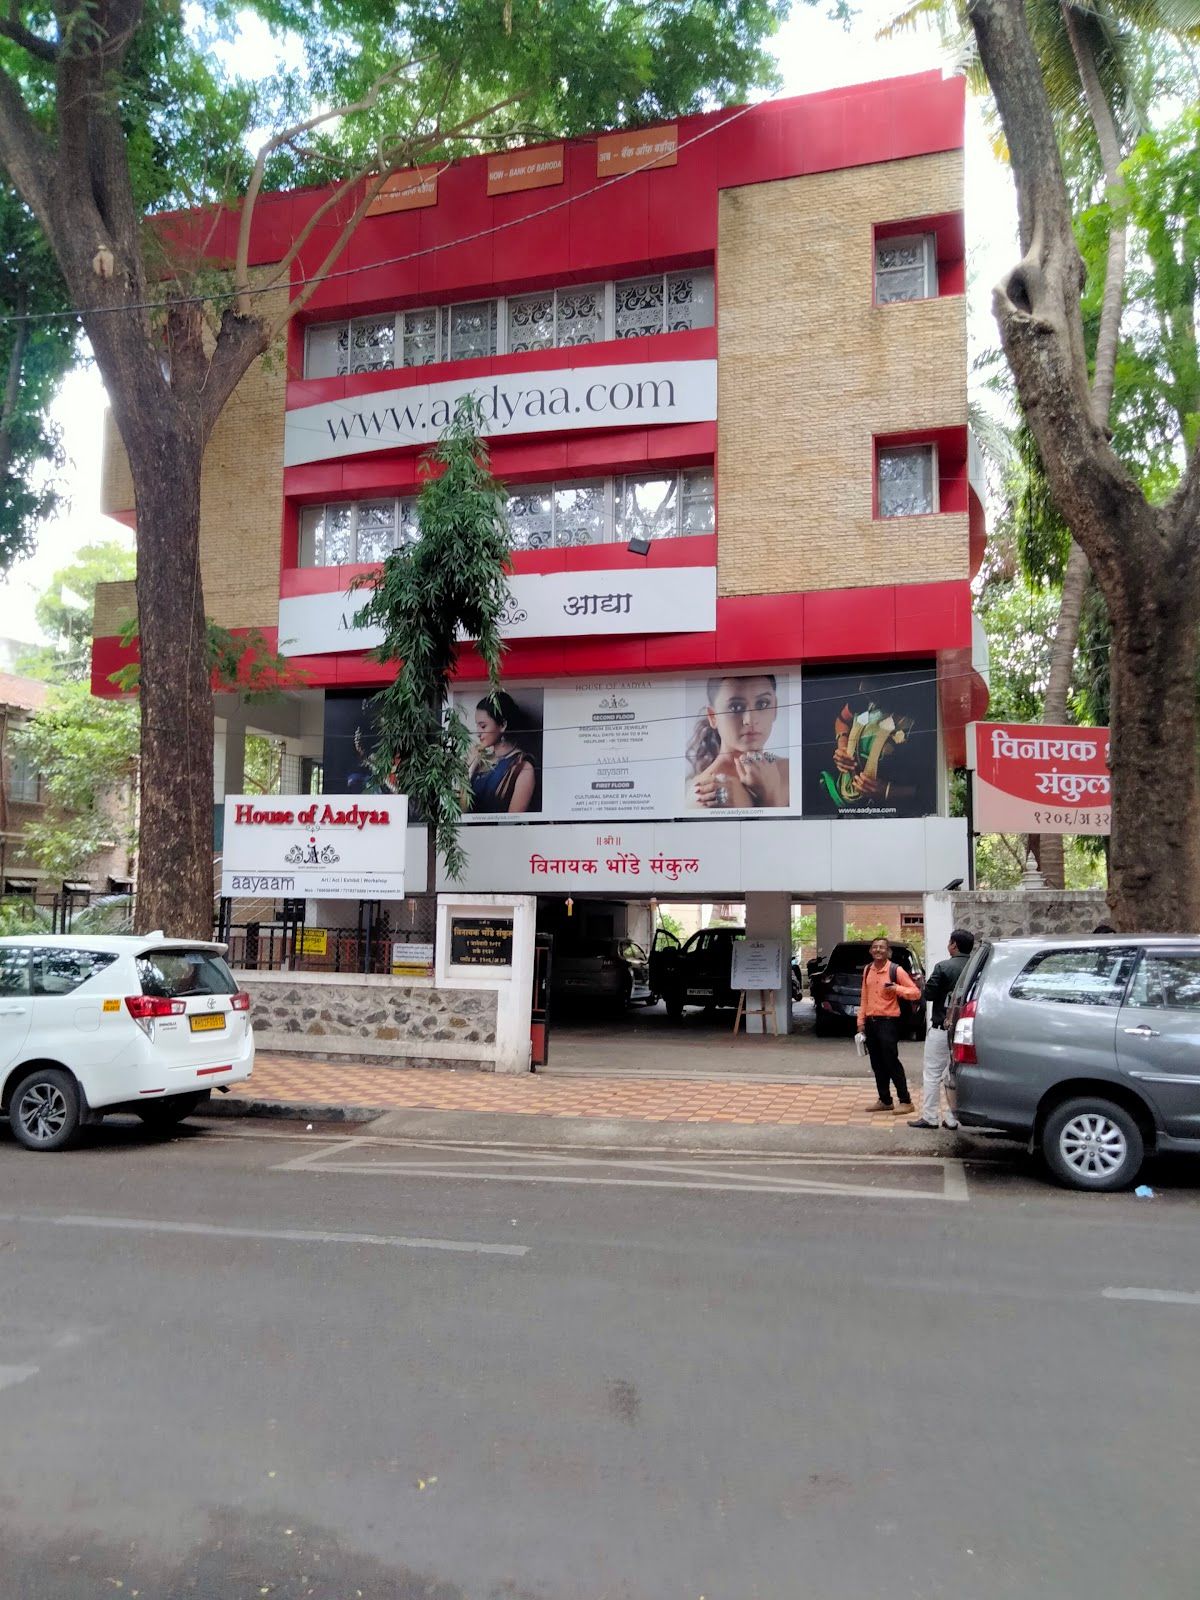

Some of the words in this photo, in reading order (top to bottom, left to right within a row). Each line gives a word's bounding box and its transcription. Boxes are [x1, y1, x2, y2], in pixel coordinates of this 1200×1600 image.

[490, 170, 504, 180] NOW
[509, 166, 526, 177] BANK
[527, 164, 536, 174] OF
[536, 160, 562, 172] BARODA
[327, 376, 676, 443] www.aadyaa.com
[563, 592, 633, 617] आद्या
[576, 684, 602, 692] HOUSE
[990, 730, 1097, 761] विनायक
[597, 768, 629, 776] aayaam
[1035, 767, 1111, 802] संकुल
[234, 804, 294, 825] House
[298, 804, 319, 825] of
[320, 804, 390, 830] Aadyaa
[530, 854, 598, 874] विनायक
[606, 852, 640, 874] भोंडे
[649, 852, 700, 880] संकुल
[232, 875, 295, 894] aayaam
